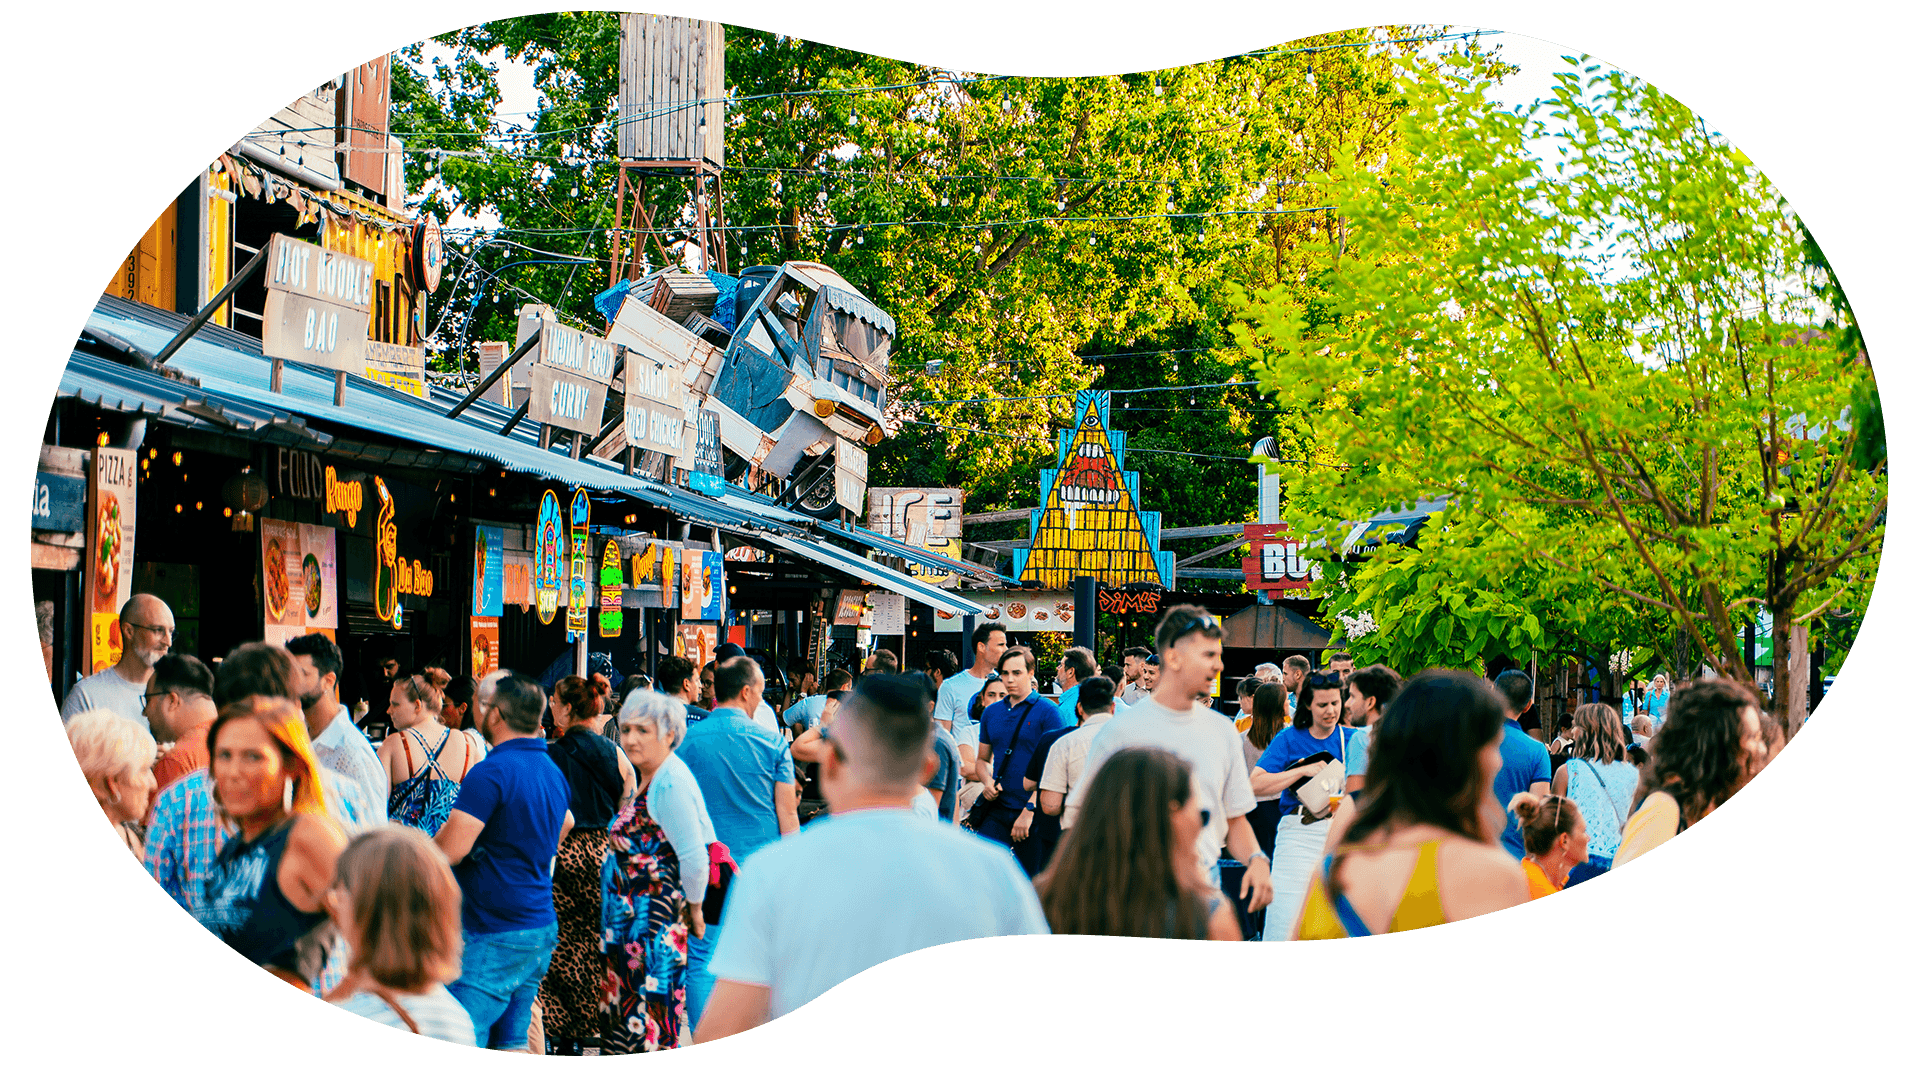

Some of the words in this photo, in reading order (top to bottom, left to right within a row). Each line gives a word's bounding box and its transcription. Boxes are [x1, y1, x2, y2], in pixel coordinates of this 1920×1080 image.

[274, 239, 311, 291] HOT
[317, 251, 373, 306] NOODLE
[304, 307, 339, 354] BAO
[547, 325, 585, 371] INDIAN
[586, 338, 615, 380] FOOD
[551, 379, 590, 422] CURRY
[638, 363, 669, 400] SANDO
[650, 409, 683, 450] CHICKEN
[98, 453, 126, 487] PIZZA
[278, 447, 323, 499] FOOD
[325, 465, 363, 529] Rango
[398, 556, 413, 594] Da
[413, 559, 434, 597] Bao
